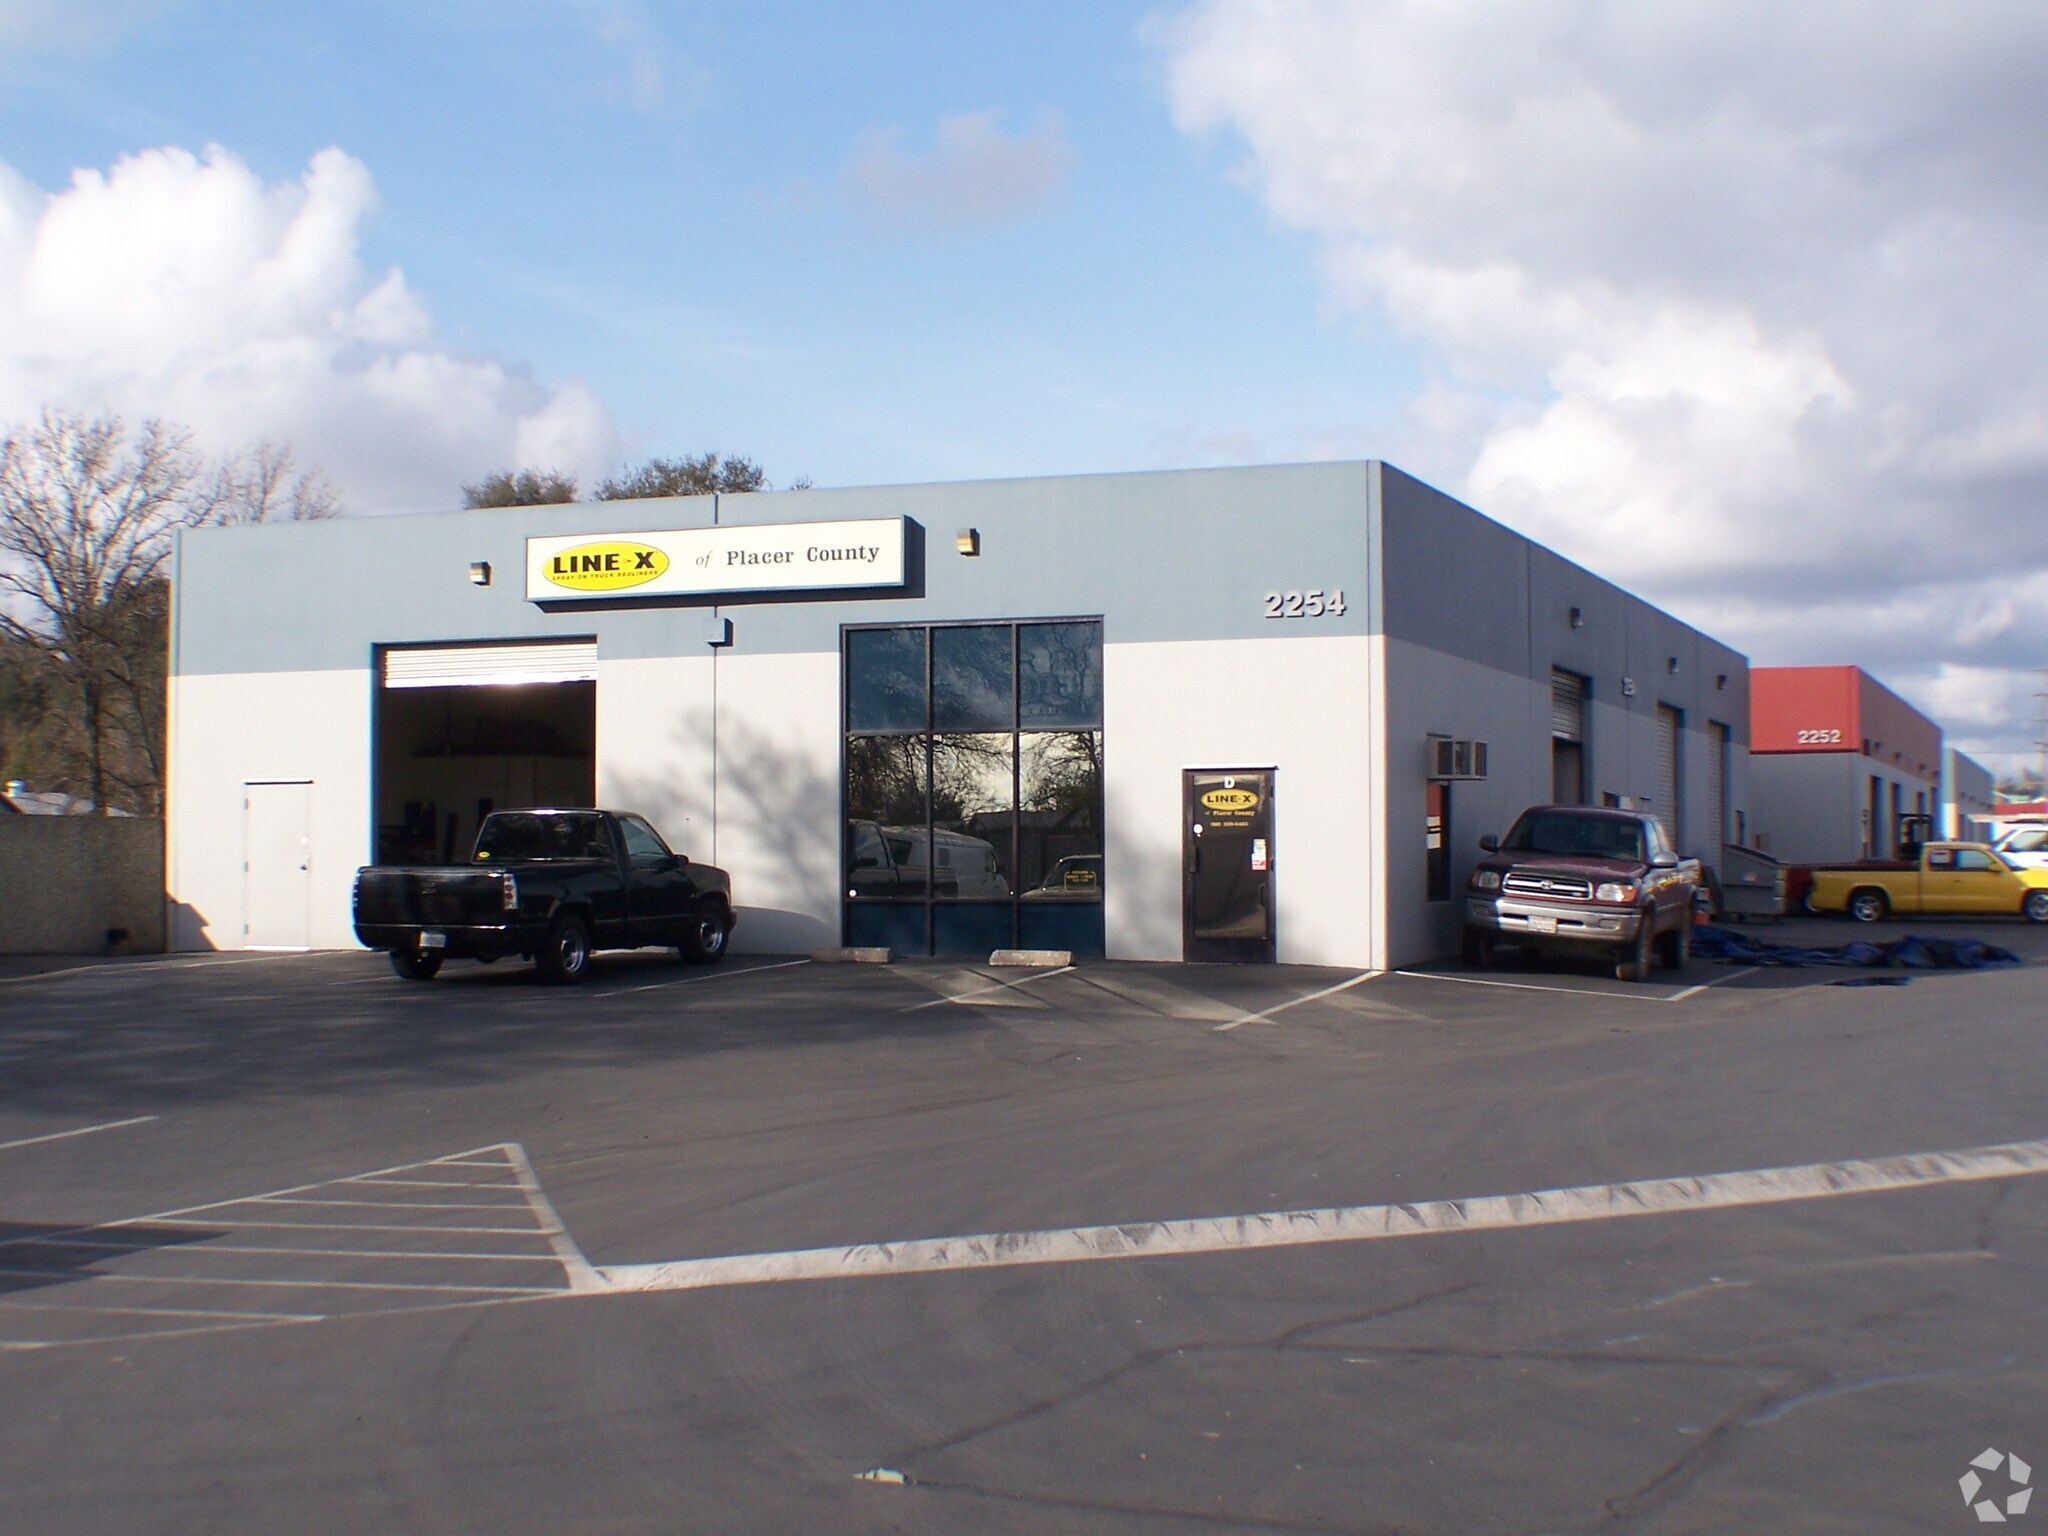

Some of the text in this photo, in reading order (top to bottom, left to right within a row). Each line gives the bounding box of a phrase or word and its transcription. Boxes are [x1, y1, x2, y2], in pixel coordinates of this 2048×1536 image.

[695, 545, 880, 568] of Placer County
[617, 570, 658, 578] BEDLINERS
[1264, 589, 1347, 618] 2254
[1798, 729, 1842, 744] 2252
[1224, 776, 1236, 789] D
